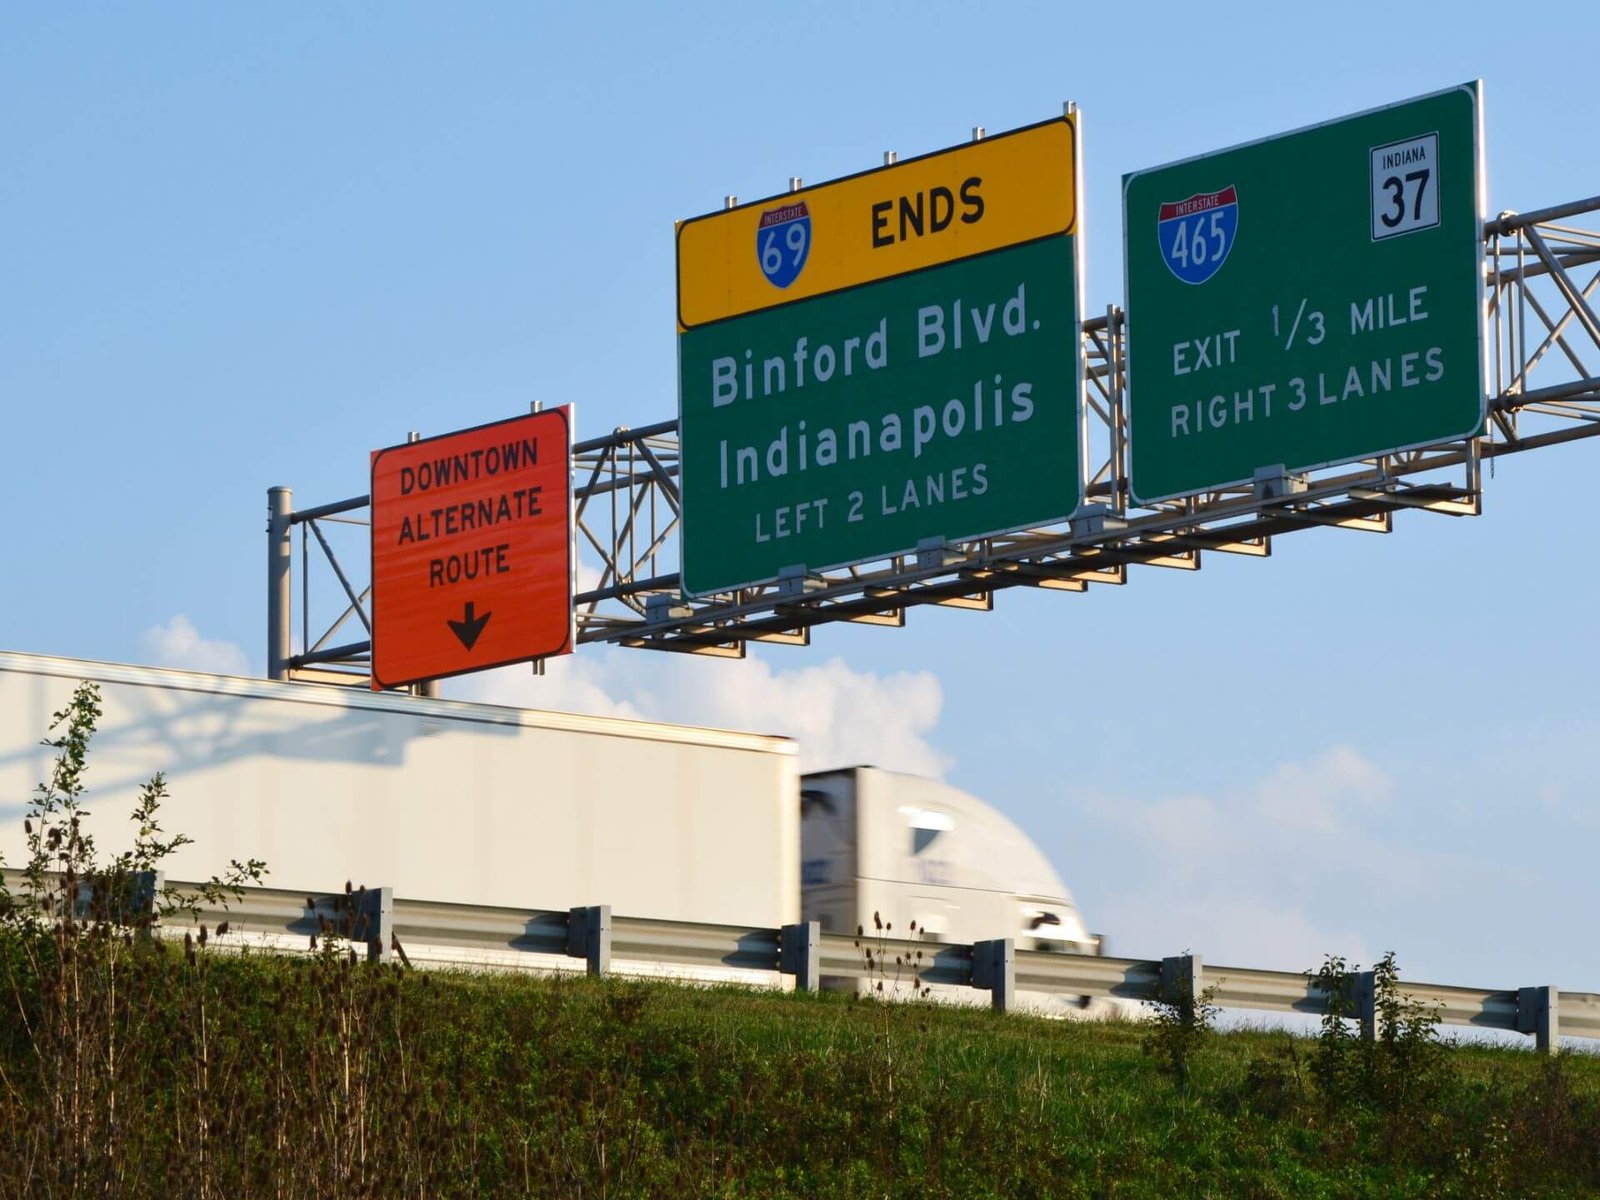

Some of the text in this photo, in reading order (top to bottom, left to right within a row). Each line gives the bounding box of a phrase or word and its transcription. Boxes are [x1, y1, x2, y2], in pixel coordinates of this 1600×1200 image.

[1383, 146, 1426, 170] INDIANA
[763, 206, 802, 225] INTERSTATE
[872, 176, 985, 249] ENDS
[1176, 195, 1219, 216] INTERSTATE
[1381, 168, 1430, 228] 37
[762, 223, 806, 275] 69
[1171, 211, 1225, 268] 465
[712, 283, 1041, 408] Binford Blvd.
[1173, 329, 1241, 376] EXIT
[1351, 285, 1428, 335] MILE
[1171, 347, 1445, 438] RIGHT 3 LANES
[720, 374, 1034, 489] Indianapolis
[401, 437, 538, 496] DOWNTOWN
[398, 486, 542, 546] ALTERNATE
[755, 463, 989, 543] LEFT 2 LANES
[429, 543, 510, 588] ROUTE
